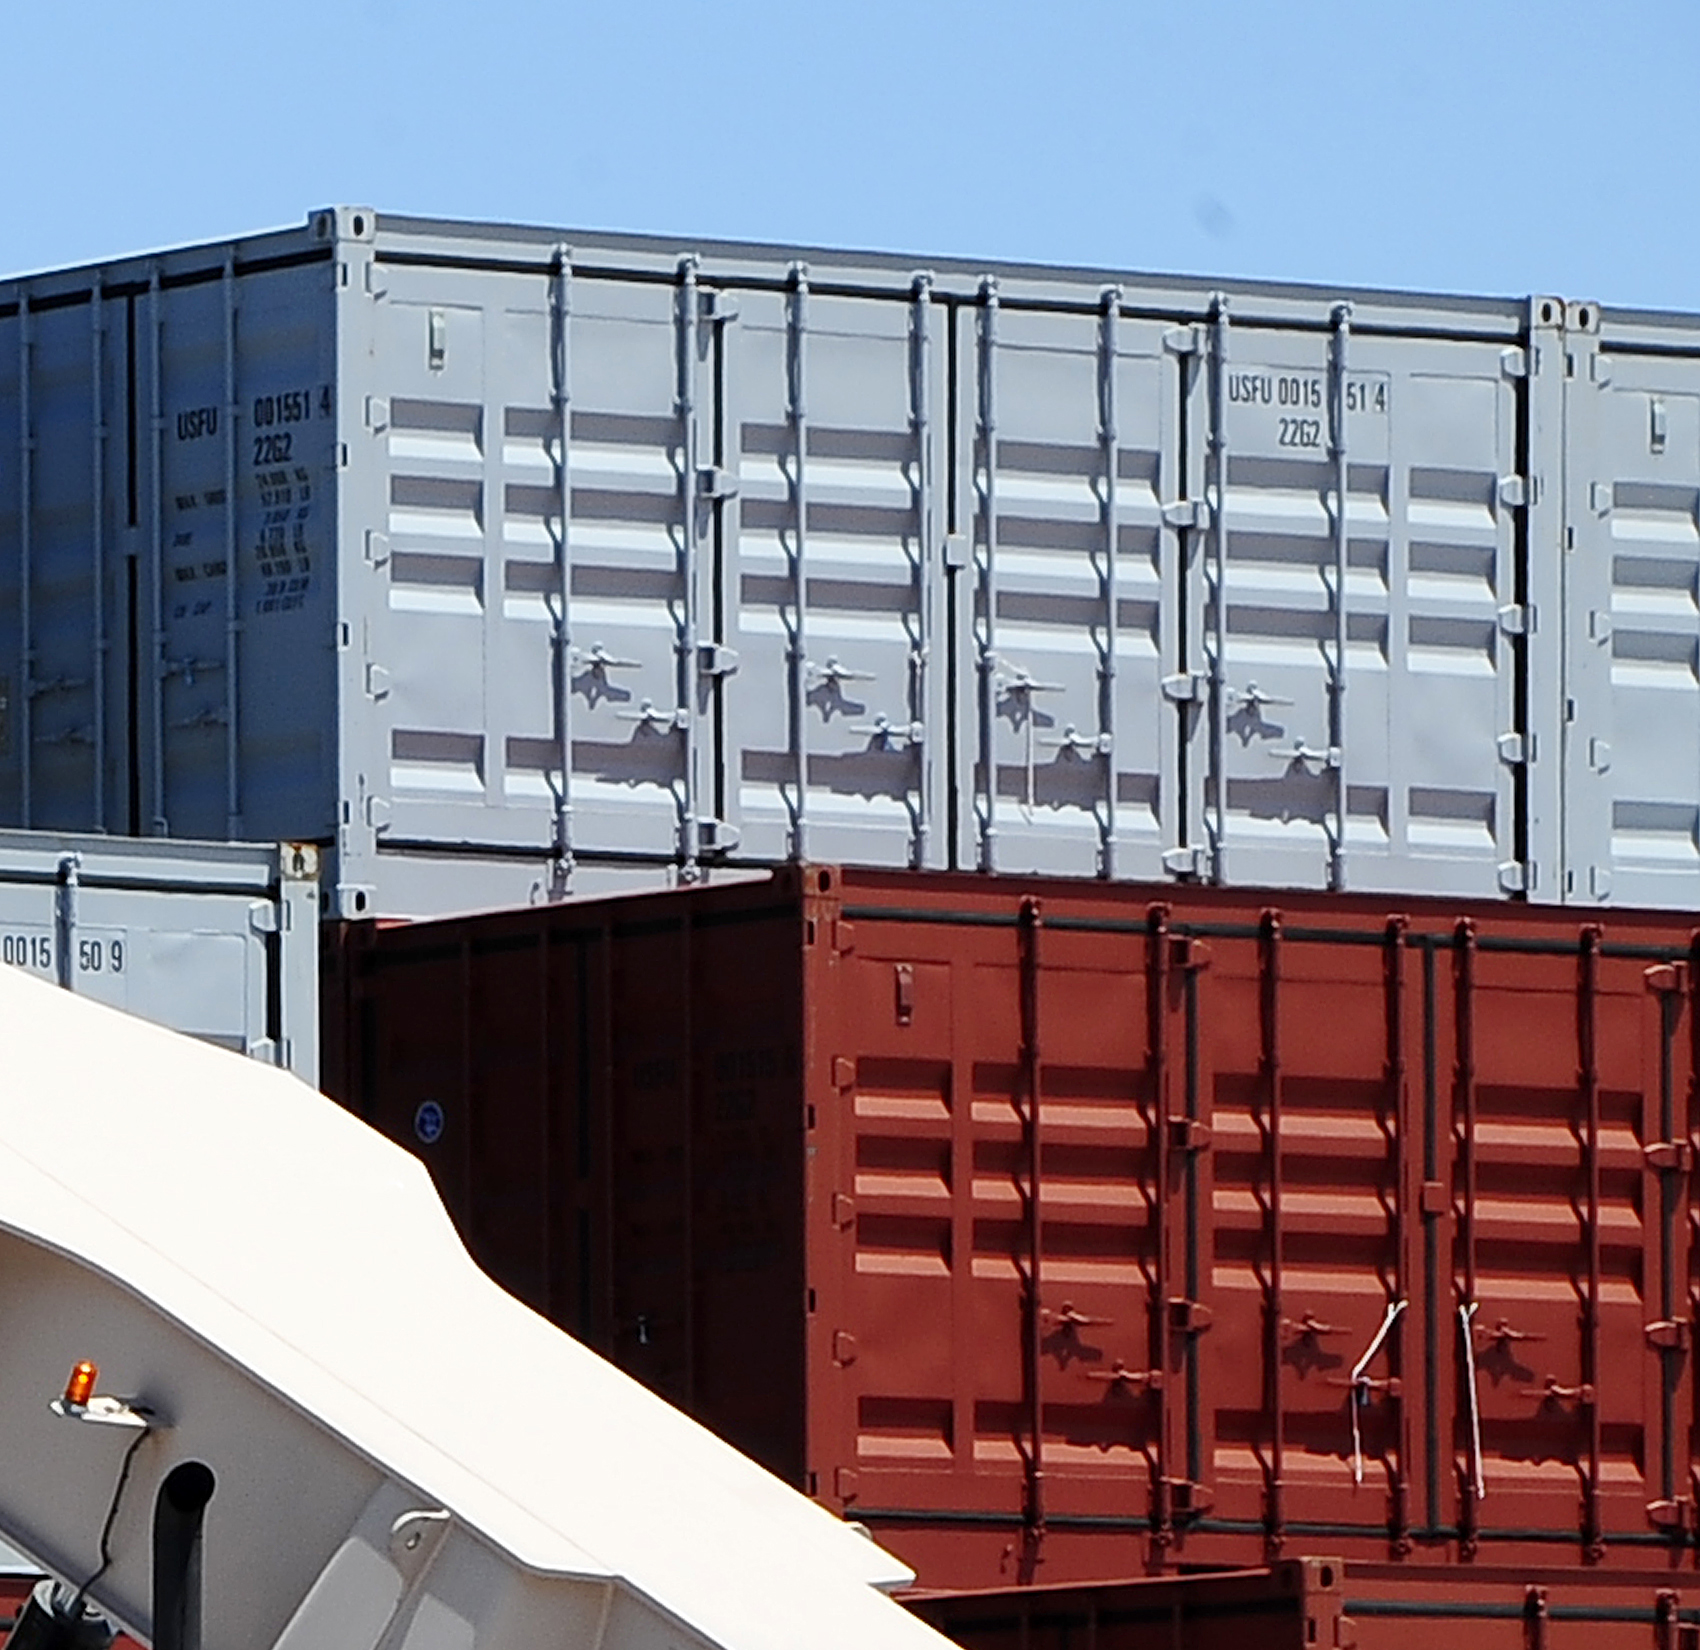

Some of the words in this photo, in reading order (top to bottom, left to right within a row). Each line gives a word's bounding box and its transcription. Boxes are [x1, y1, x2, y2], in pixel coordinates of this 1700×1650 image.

[1228, 373, 1273, 406] USFU
[1278, 377, 1321, 410] 0015
[1373, 382, 1386, 413] 4
[177, 406, 217, 441] USFU
[253, 390, 310, 428] 001551
[1279, 418, 1321, 448] 22G2
[253, 432, 293, 466] 22G2
[3, 935, 51, 968] 0015
[79, 939, 102, 972] 50
[110, 941, 123, 972] 9
